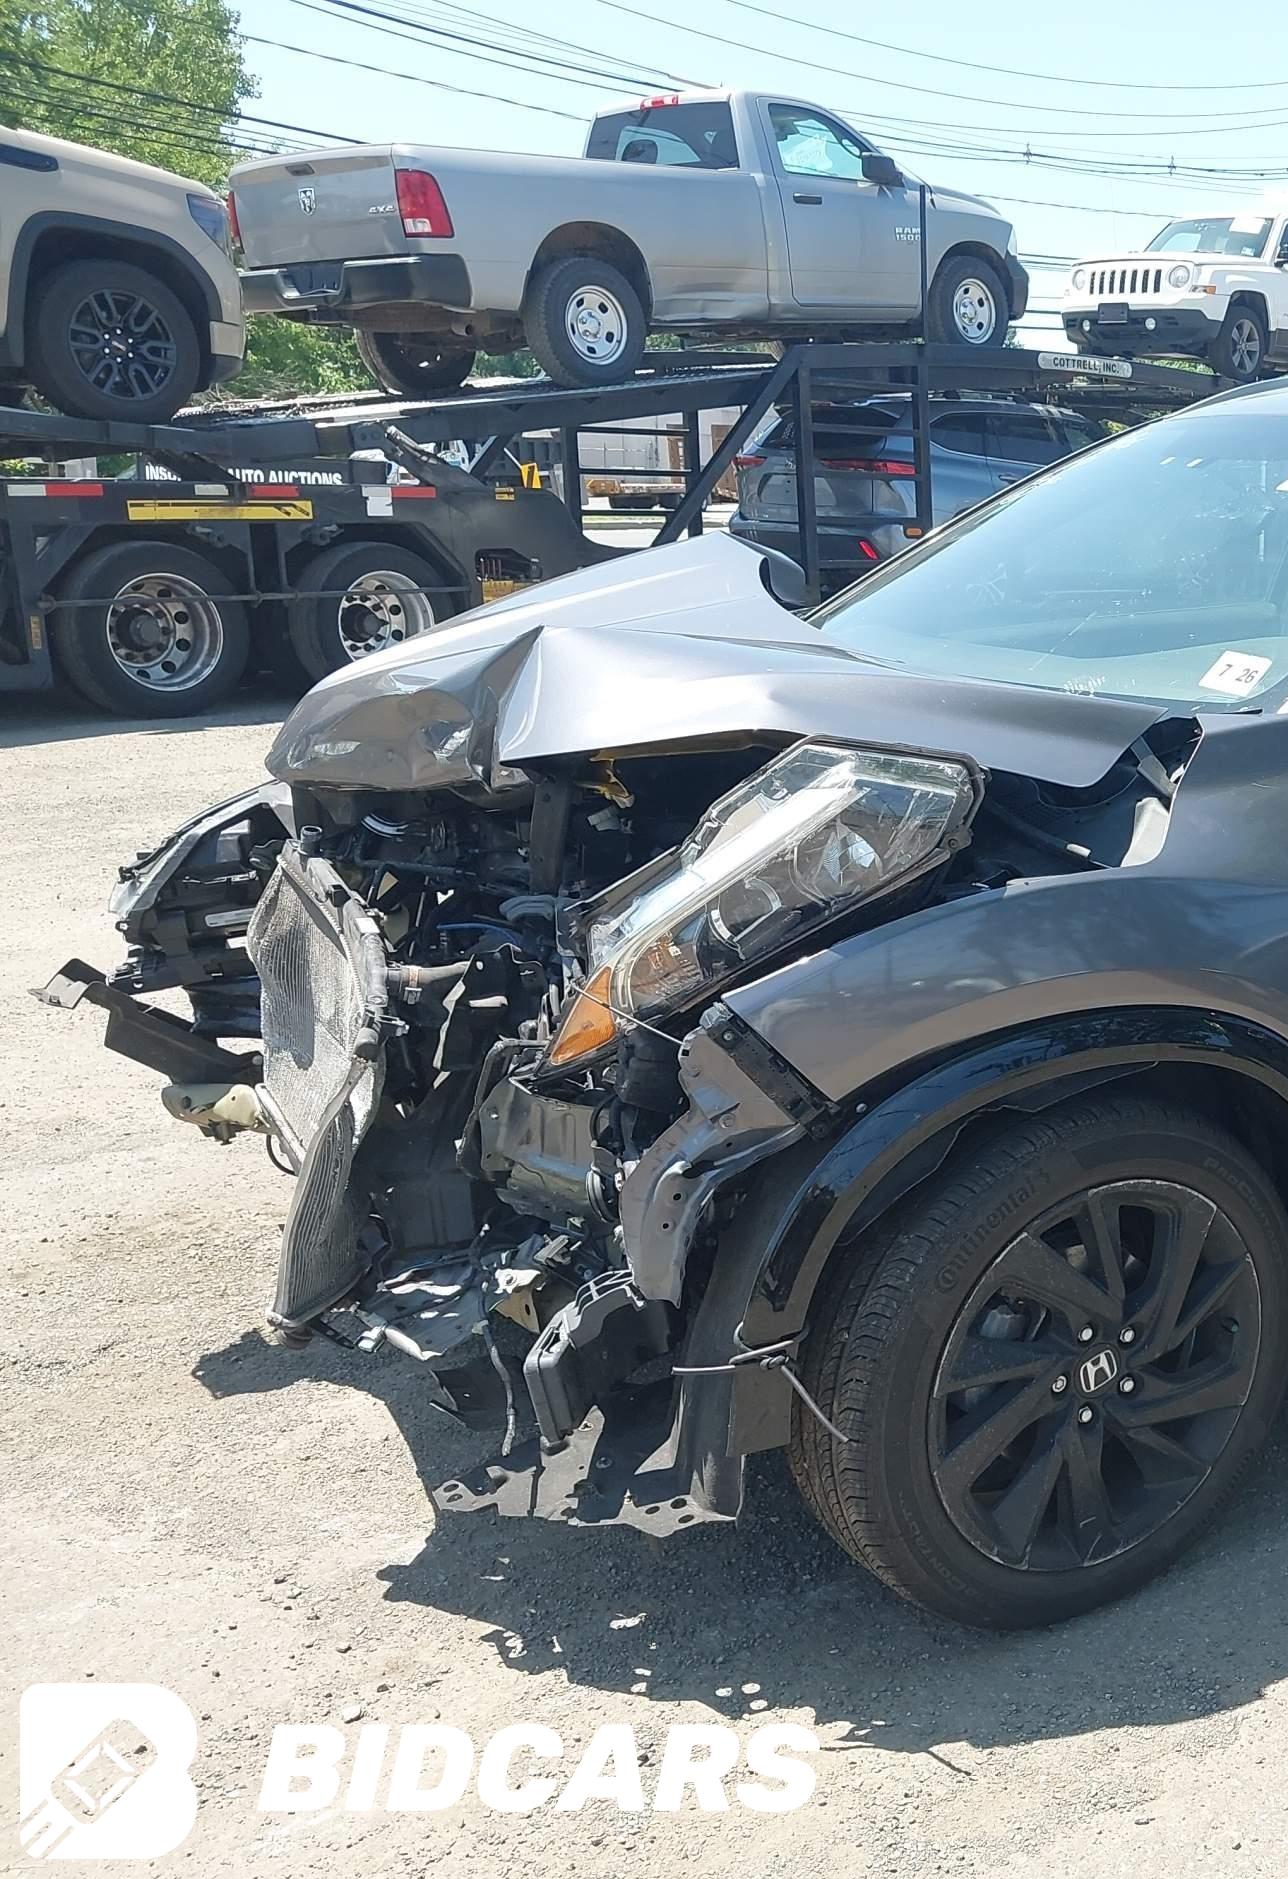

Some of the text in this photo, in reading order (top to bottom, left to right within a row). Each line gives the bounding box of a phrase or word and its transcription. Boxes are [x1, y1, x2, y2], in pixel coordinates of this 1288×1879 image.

[1103, 361, 1119, 374] INC.
[269, 470, 344, 485] AUCTIONS
[1218, 663, 1259, 683] 7 26
[936, 1176, 1038, 1291] Continental
